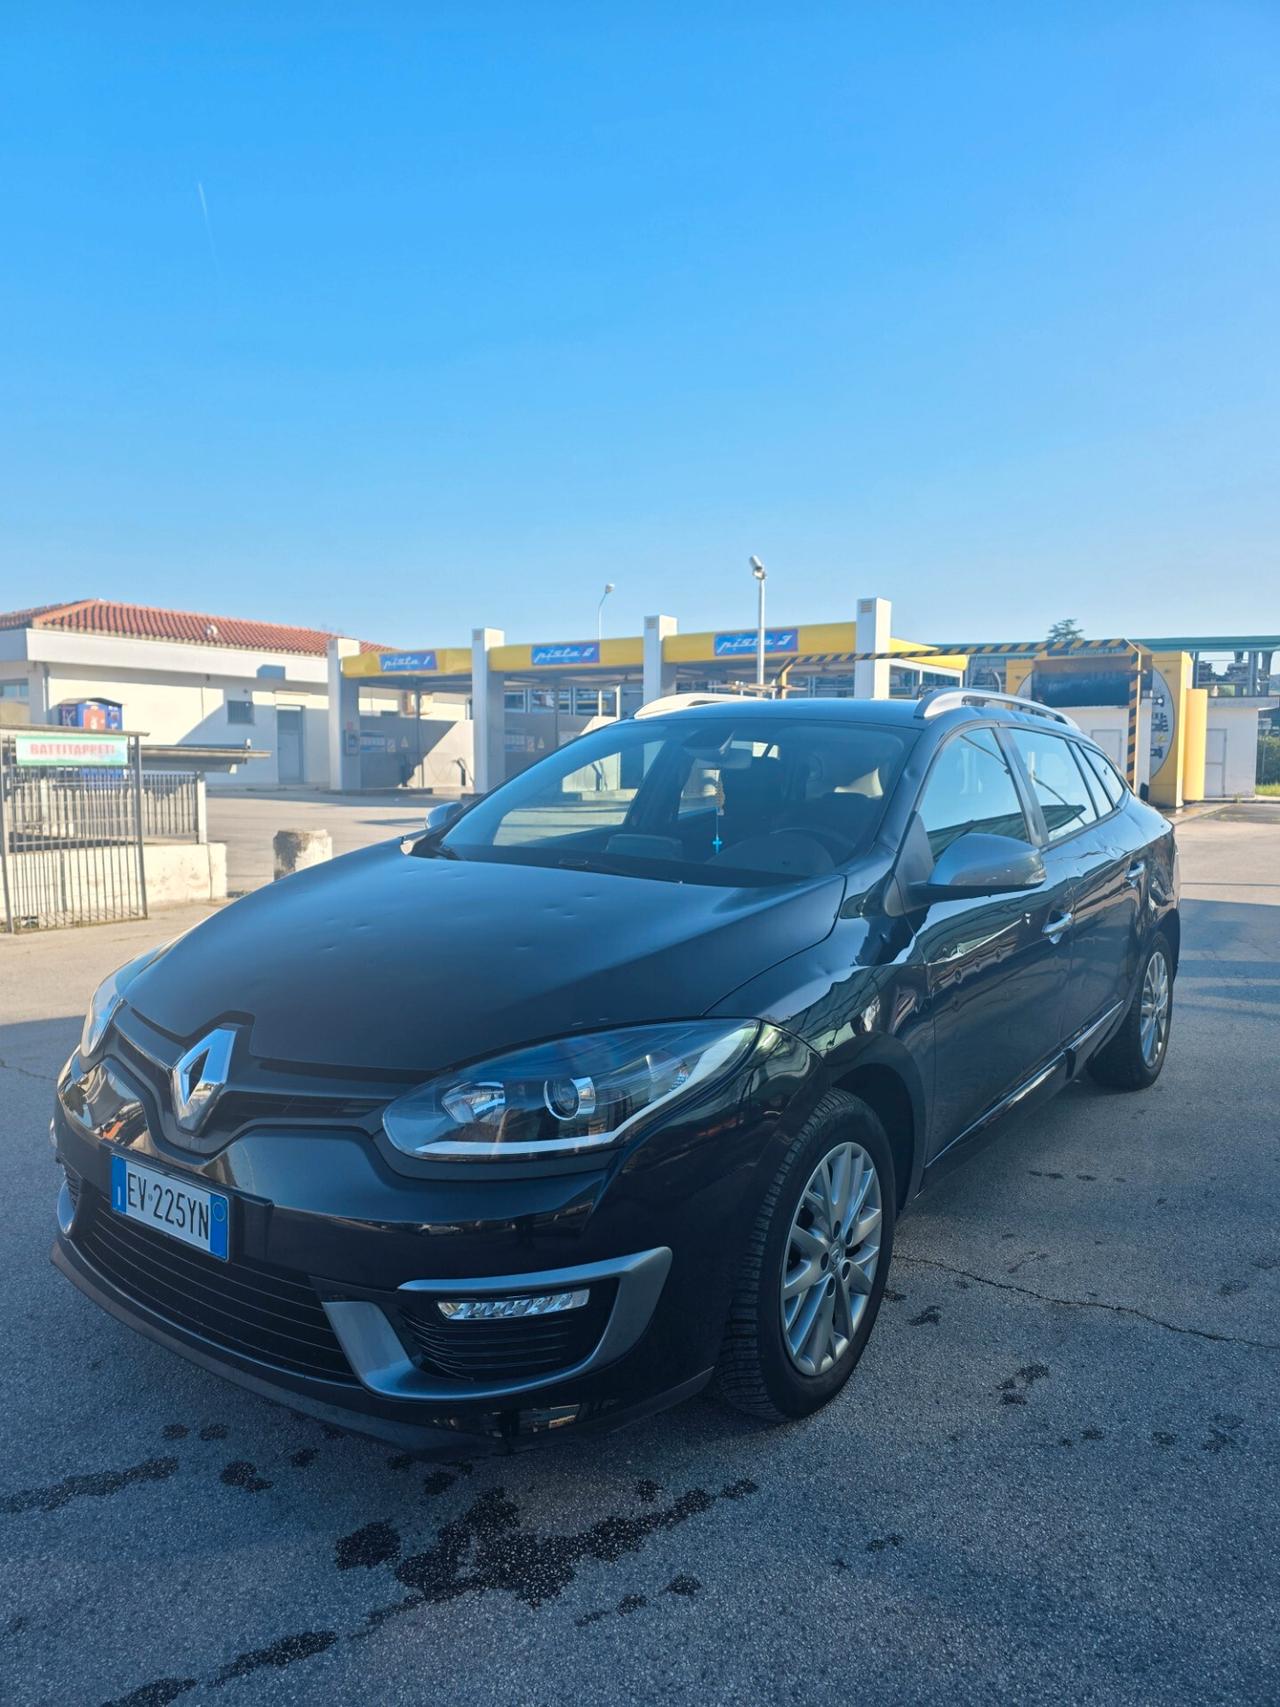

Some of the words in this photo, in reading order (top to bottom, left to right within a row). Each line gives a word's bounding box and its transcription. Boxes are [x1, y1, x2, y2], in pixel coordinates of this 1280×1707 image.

[383, 655, 419, 670] pista
[533, 647, 580, 664] pista
[30, 743, 115, 756] BATTITAPPETI
